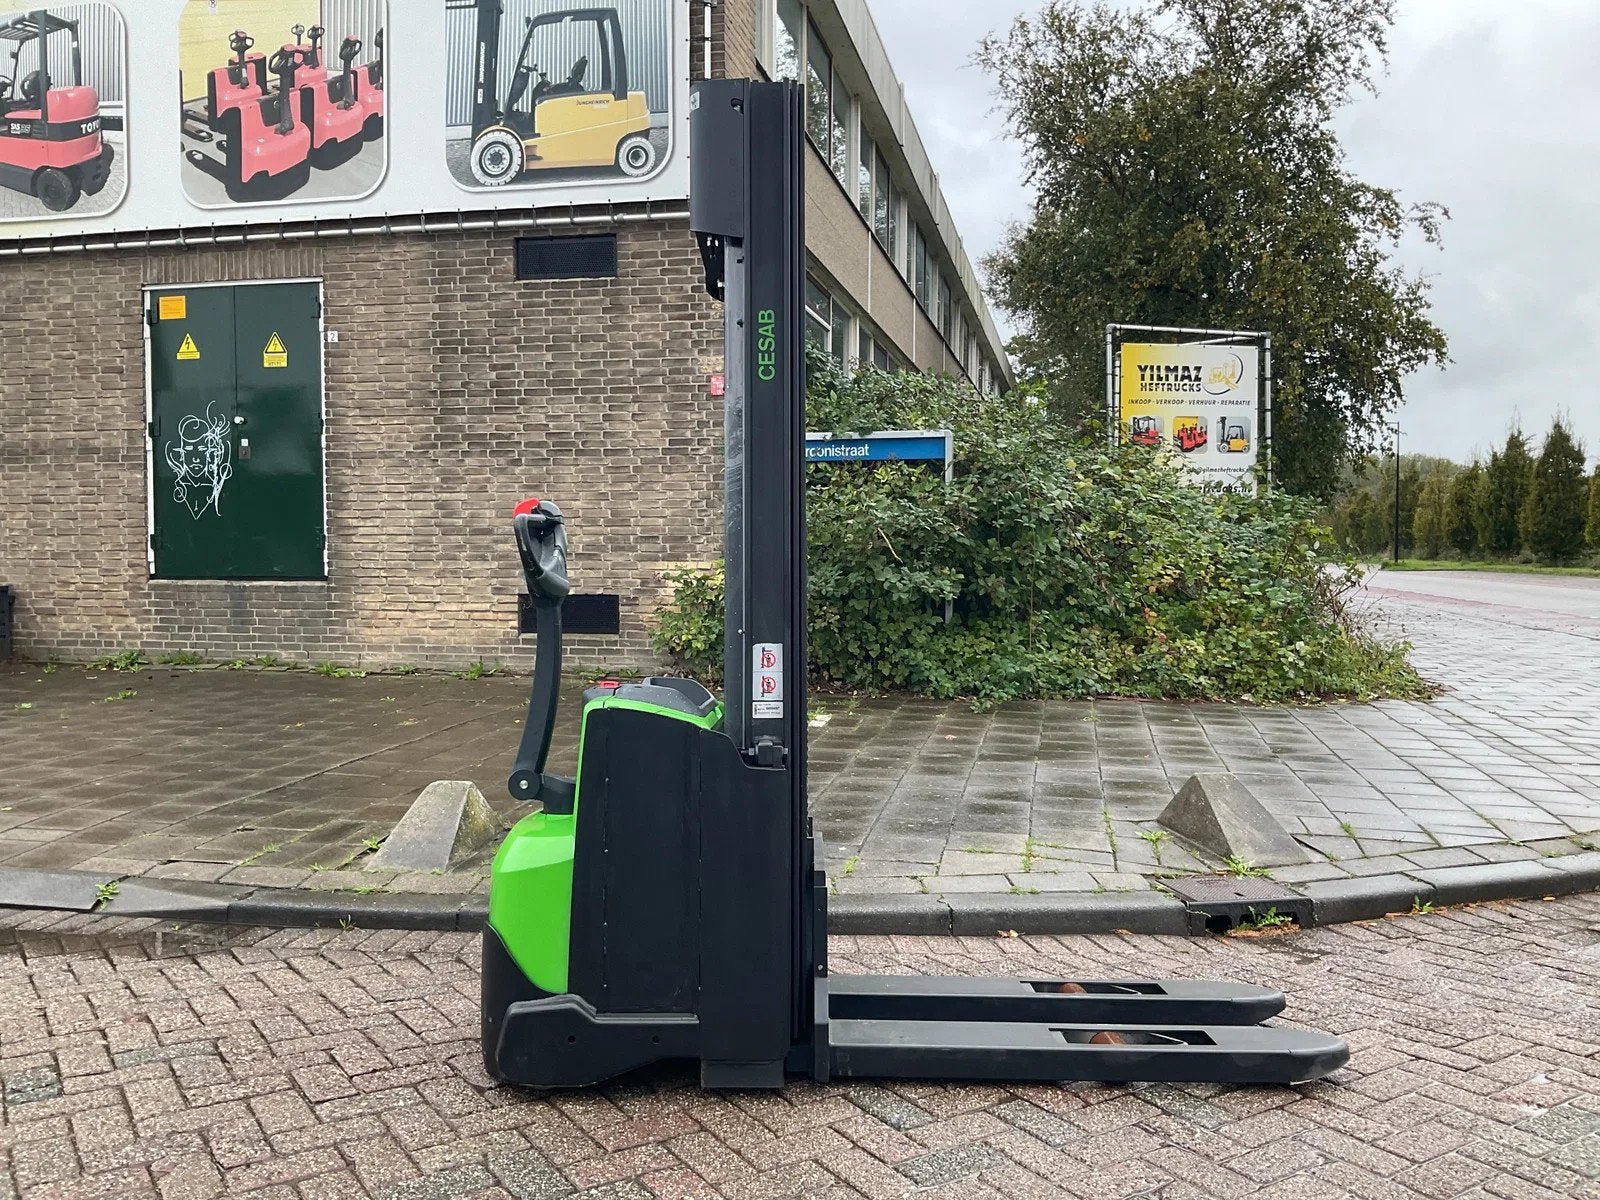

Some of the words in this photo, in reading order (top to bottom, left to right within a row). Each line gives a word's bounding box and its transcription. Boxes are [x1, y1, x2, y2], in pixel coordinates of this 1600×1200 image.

[330, 332, 336, 341] 2
[758, 309, 776, 381] CESAB
[1137, 365, 1202, 382] YILMAZ
[1140, 382, 1202, 393] HEFTRUCKS
